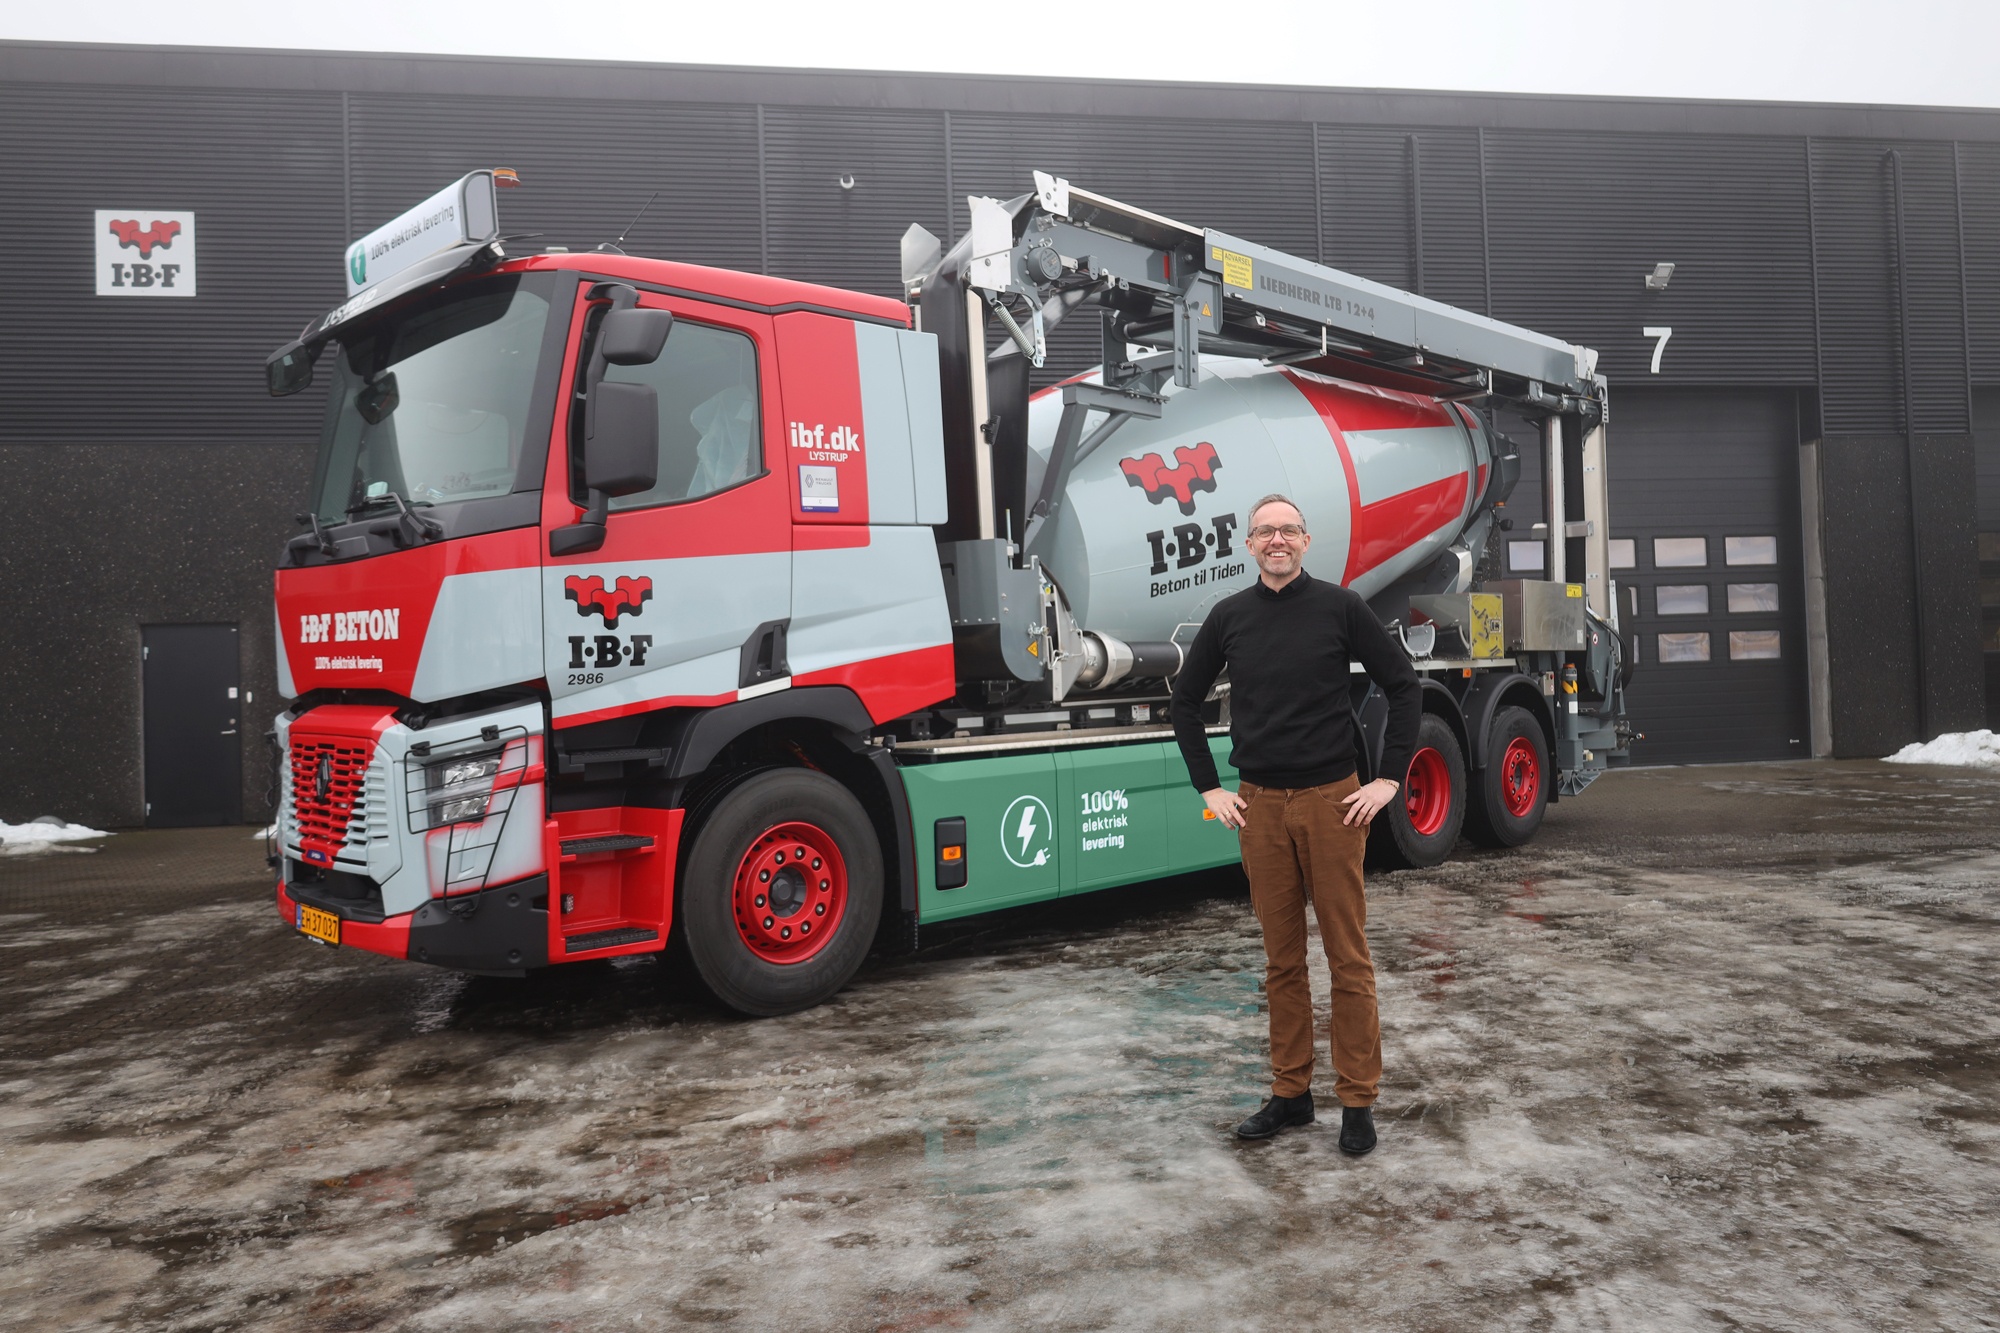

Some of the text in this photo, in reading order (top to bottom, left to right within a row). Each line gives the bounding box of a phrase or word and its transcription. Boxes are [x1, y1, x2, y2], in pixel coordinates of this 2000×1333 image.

[371, 205, 454, 260] 100% elektrisk levering
[1225, 252, 1251, 267] ADVARSEL
[1260, 275, 1375, 321] LIEBHERR LTB 12+4
[1643, 326, 1672, 374] 7
[790, 421, 860, 452] ibf.dk
[809, 451, 849, 462] LYSTRUP
[1150, 563, 1245, 598] Beton til Tiden
[334, 608, 400, 642] BETON
[357, 655, 383, 673] levering
[568, 672, 604, 686] 2986
[1081, 788, 1128, 815] 100%
[1082, 813, 1128, 833] elektrisk
[1082, 833, 1125, 851] levering
[302, 909, 337, 939] EH 37 037
